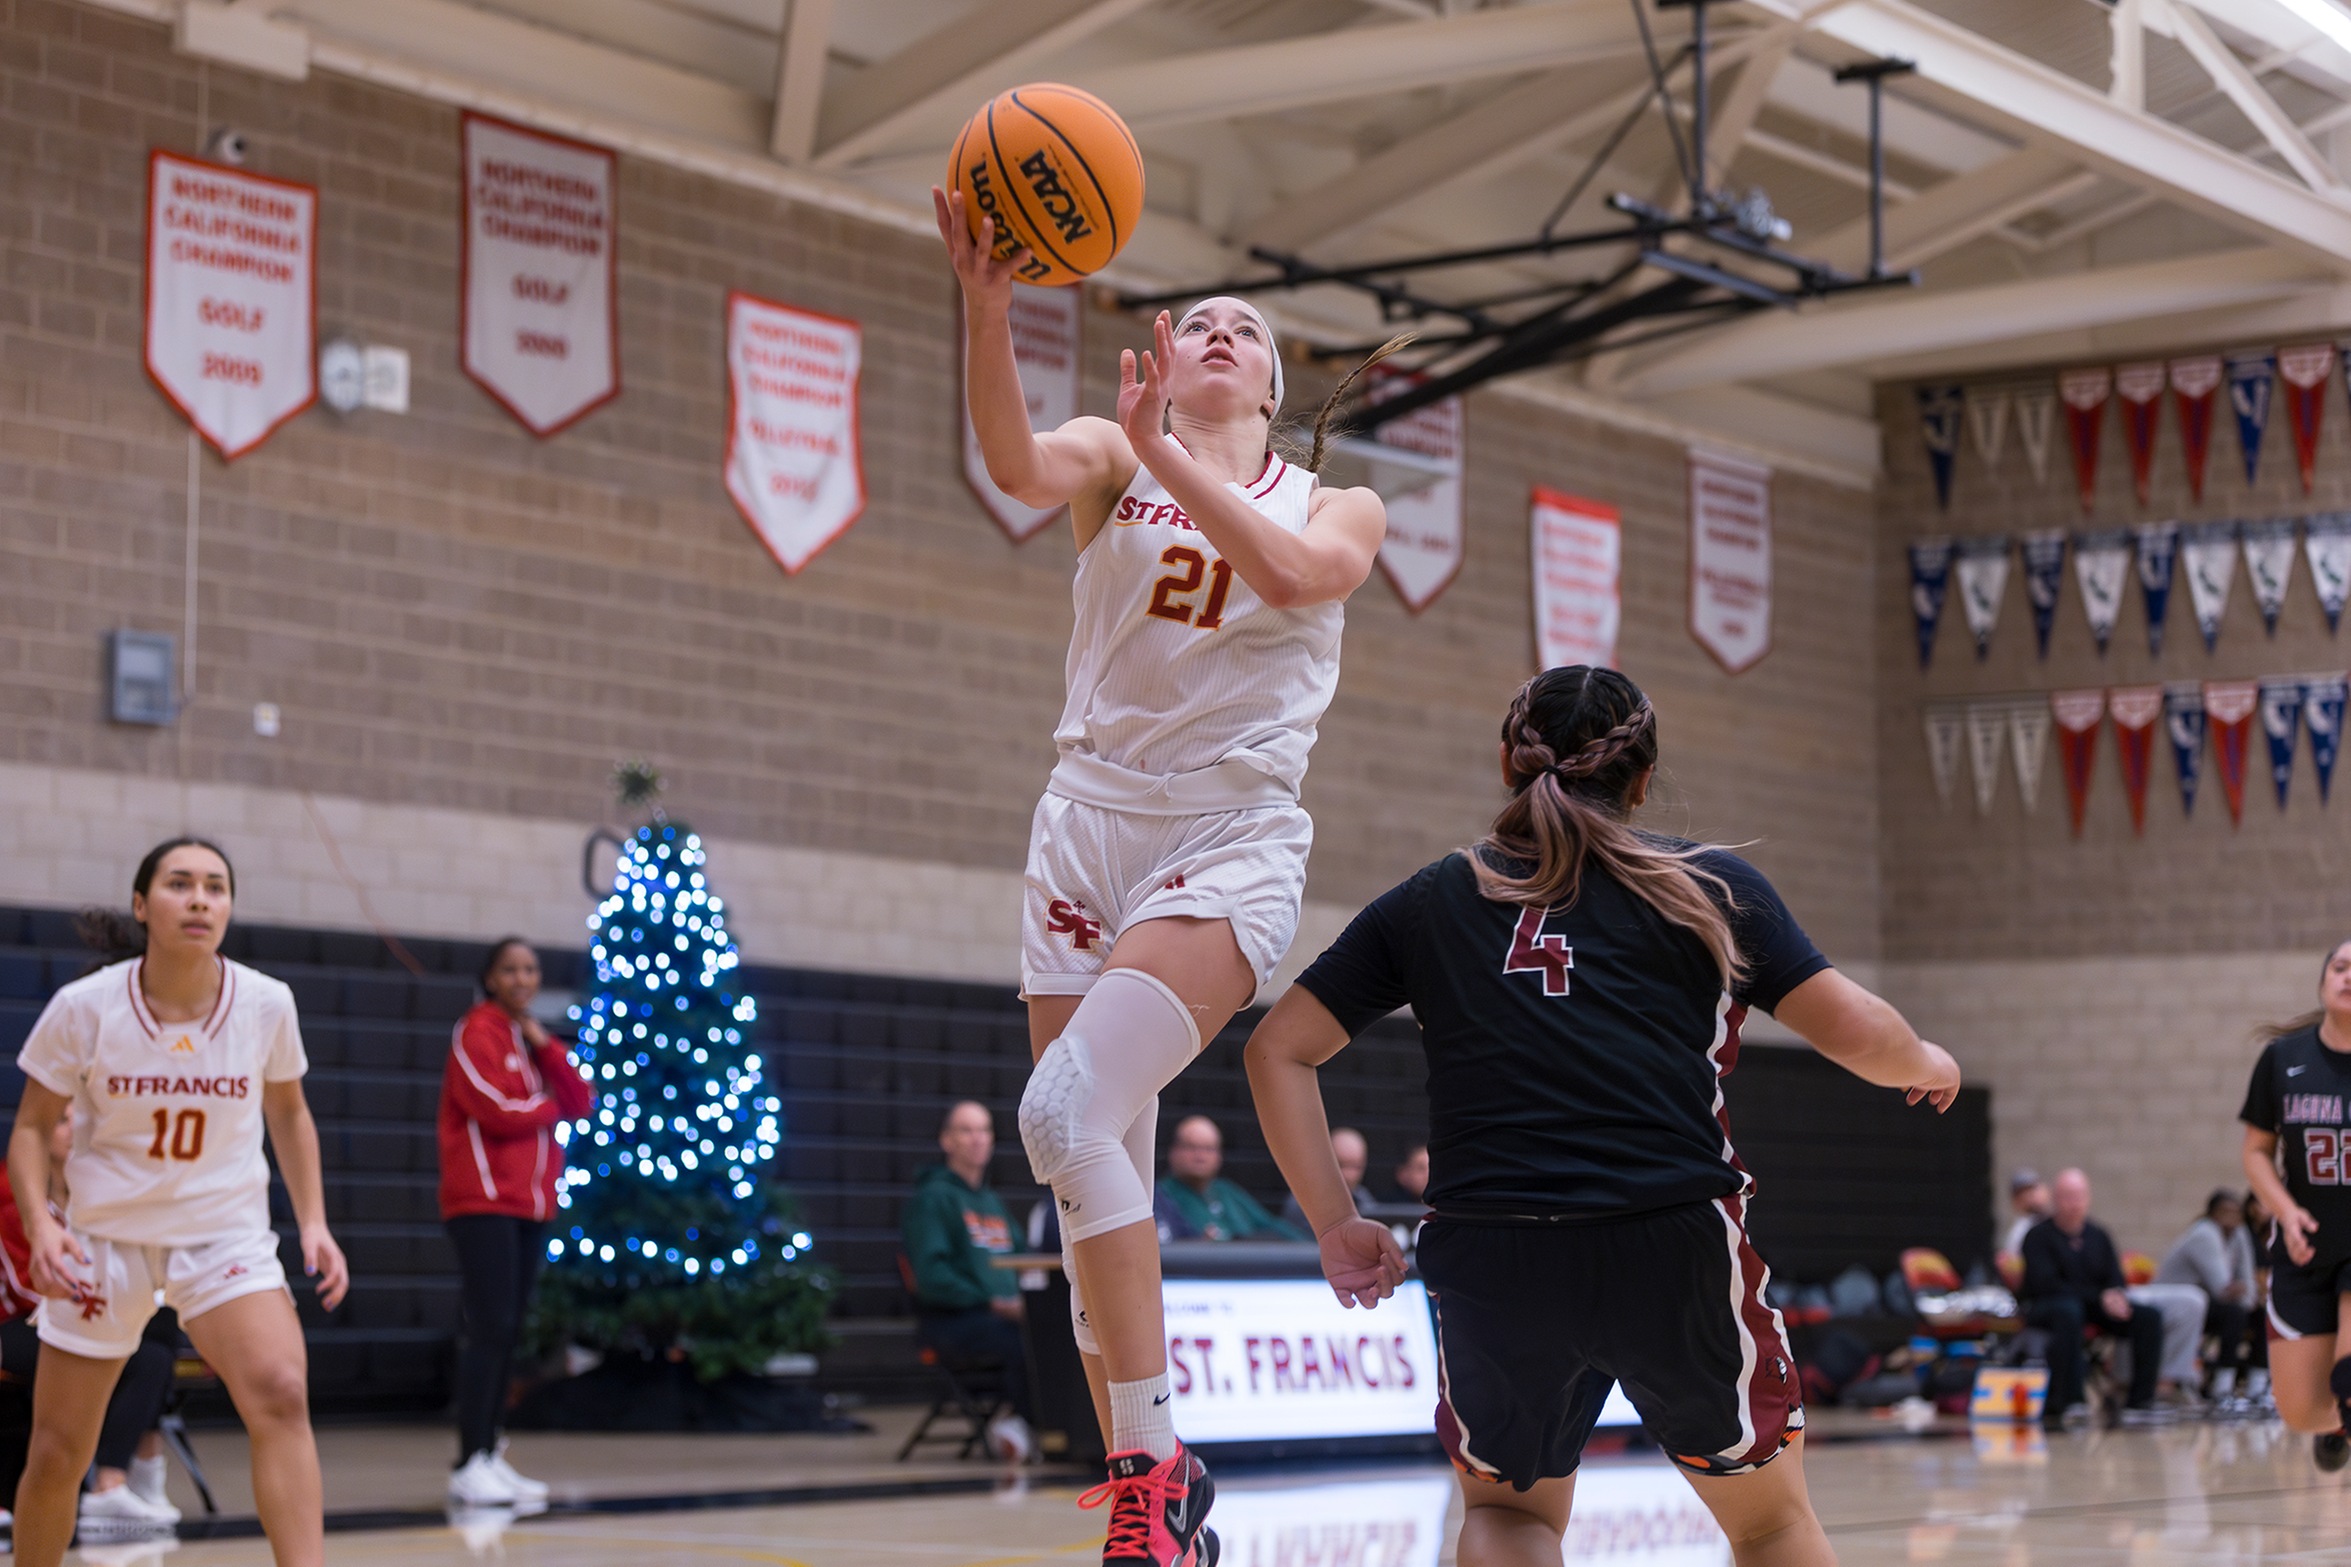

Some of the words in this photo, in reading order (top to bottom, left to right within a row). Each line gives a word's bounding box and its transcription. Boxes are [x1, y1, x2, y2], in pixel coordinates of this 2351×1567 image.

[1019, 148, 1093, 245] NCAA
[169, 236, 294, 283] CHAMPION
[197, 295, 265, 333] GOLF
[1146, 543, 1233, 631] 21
[1502, 903, 1574, 996] 4
[147, 1107, 207, 1162] 10
[1170, 1335, 1232, 1396] ST.
[1245, 1334, 1415, 1394] FRANCIS
